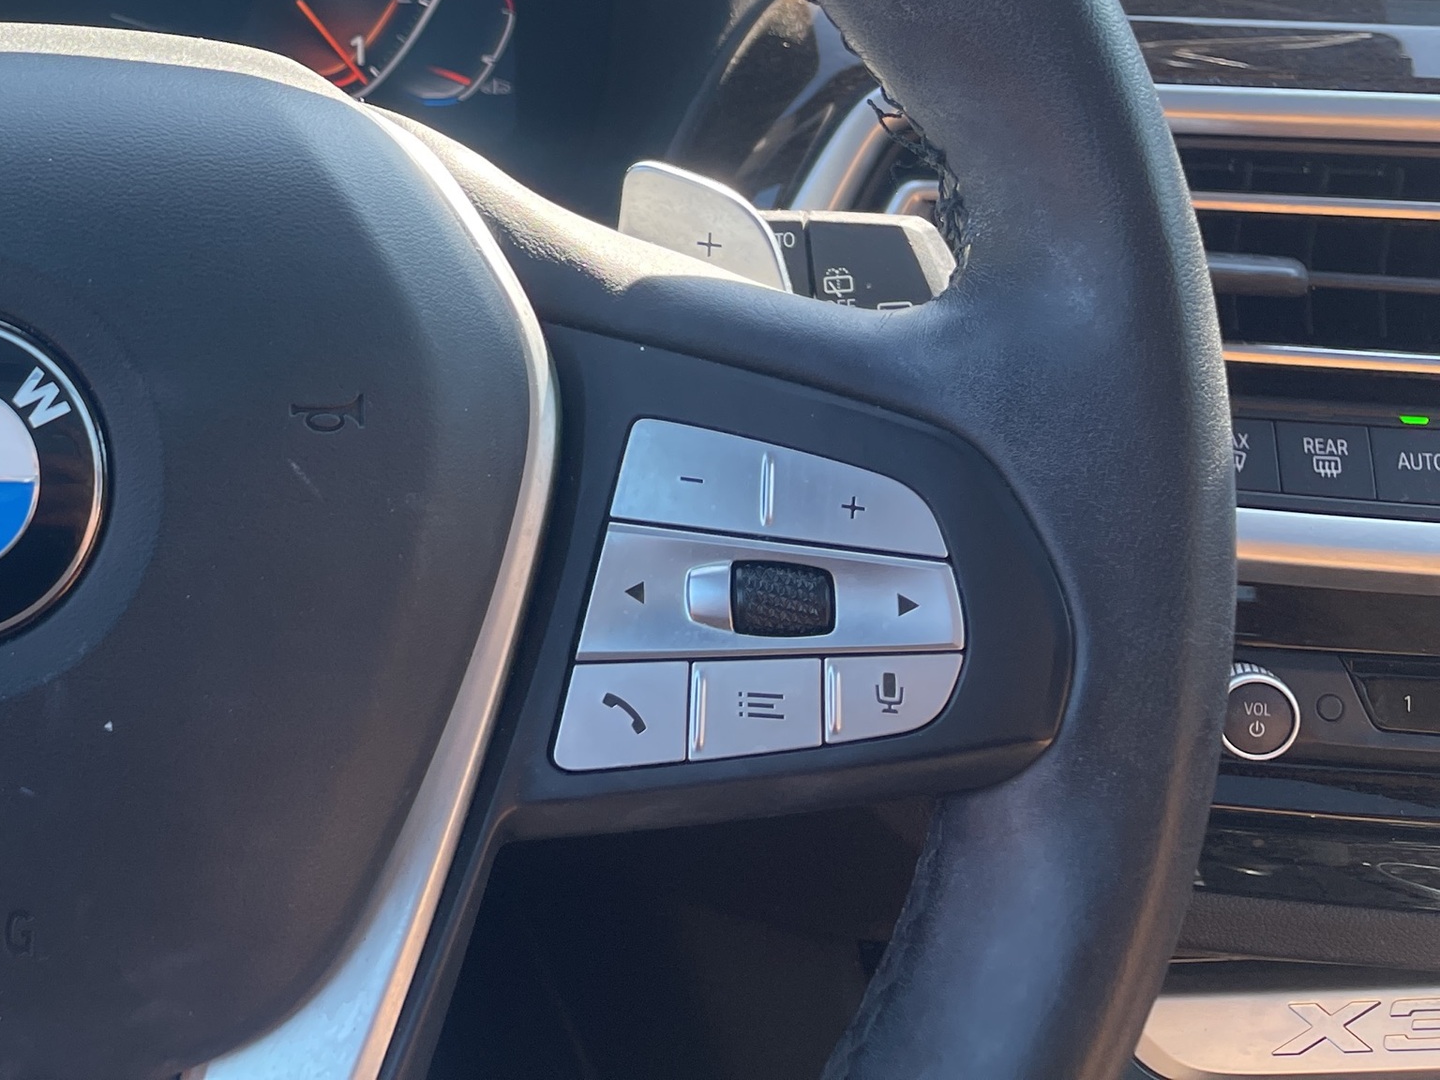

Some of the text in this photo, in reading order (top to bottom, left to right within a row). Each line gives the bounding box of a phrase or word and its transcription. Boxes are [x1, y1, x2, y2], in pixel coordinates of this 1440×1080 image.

[349, 34, 367, 67] 1
[1303, 436, 1349, 456] REAR
[1243, 701, 1272, 717] VOL
